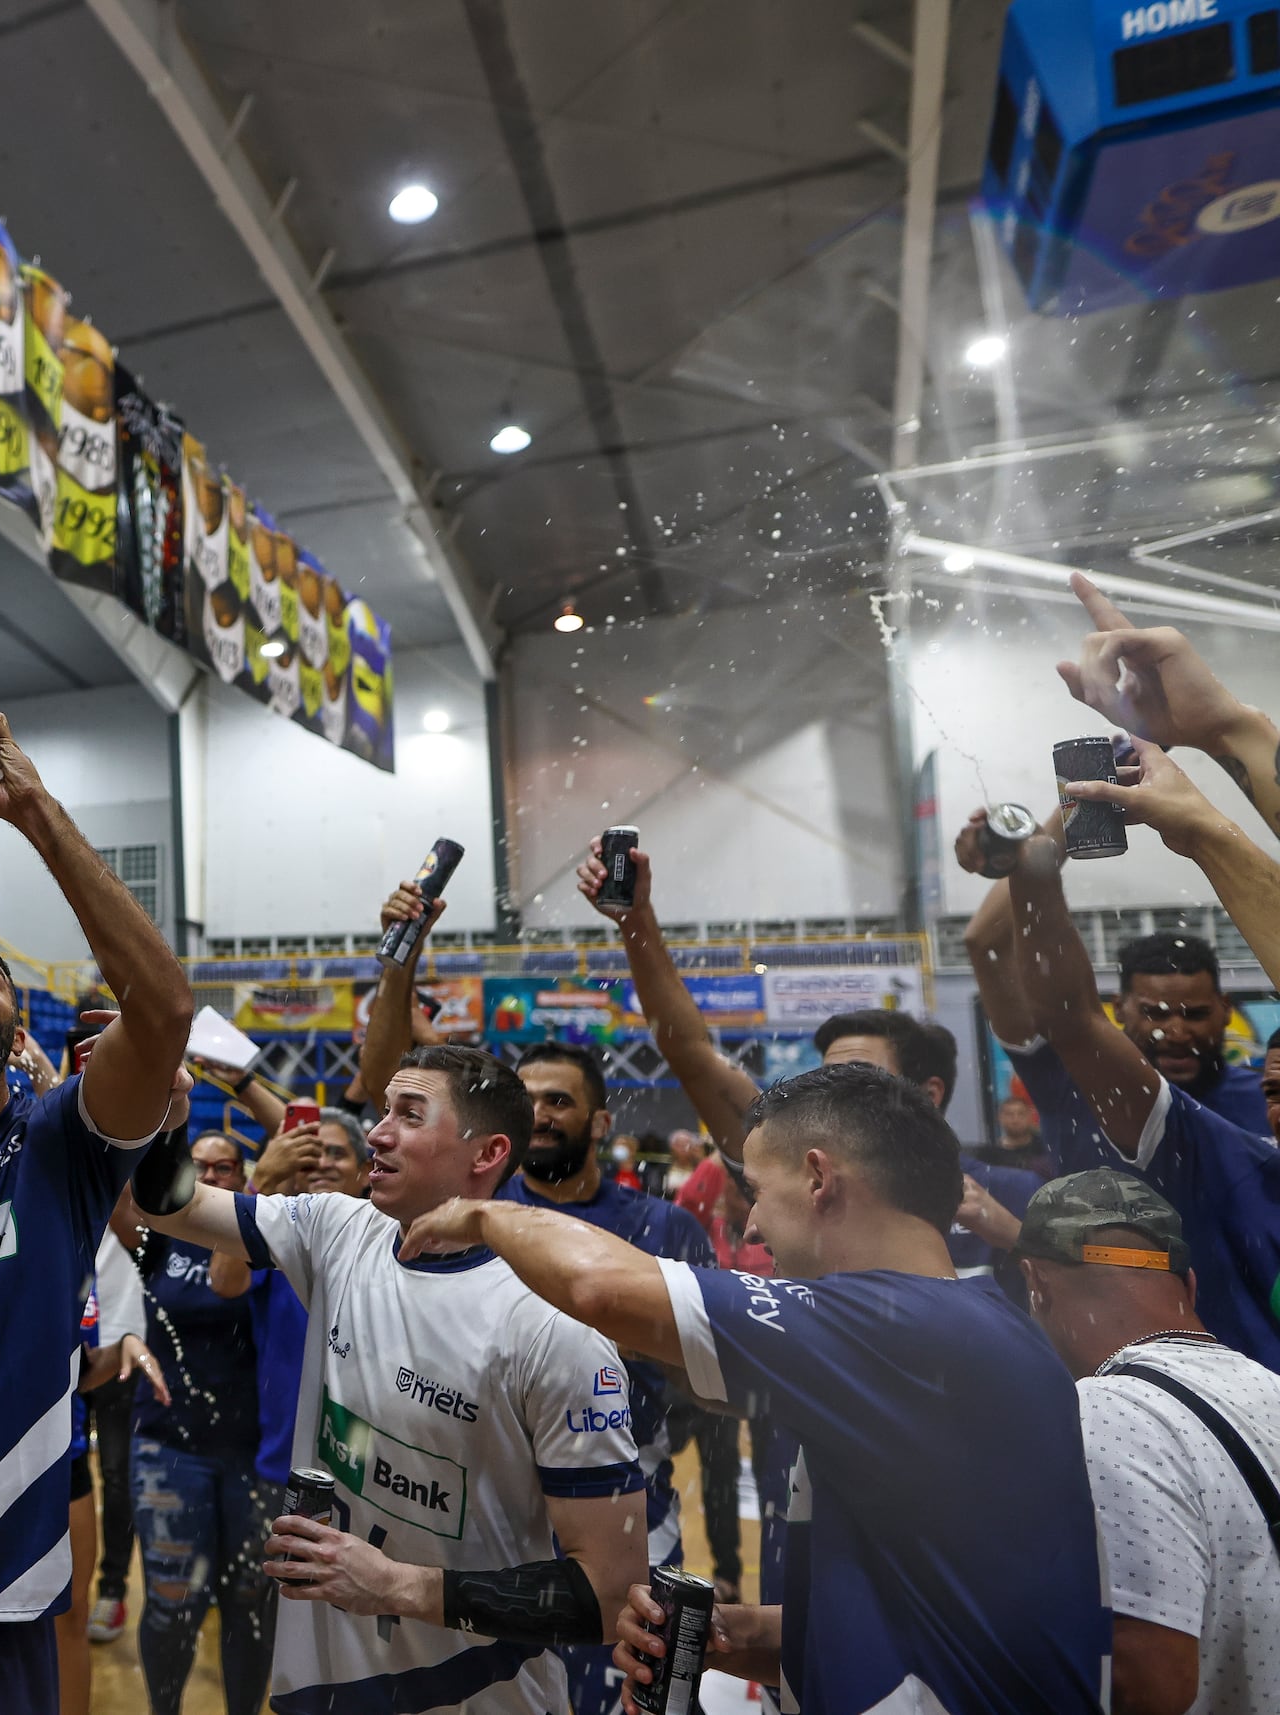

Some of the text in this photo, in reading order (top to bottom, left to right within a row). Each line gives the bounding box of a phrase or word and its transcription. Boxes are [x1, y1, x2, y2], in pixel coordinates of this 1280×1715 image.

[1122, 0, 1218, 40] HOME
[730, 1269, 786, 1333] erty
[411, 1380, 480, 1423] mets
[567, 1406, 630, 1433] Libert
[373, 1456, 451, 1513] Bank
